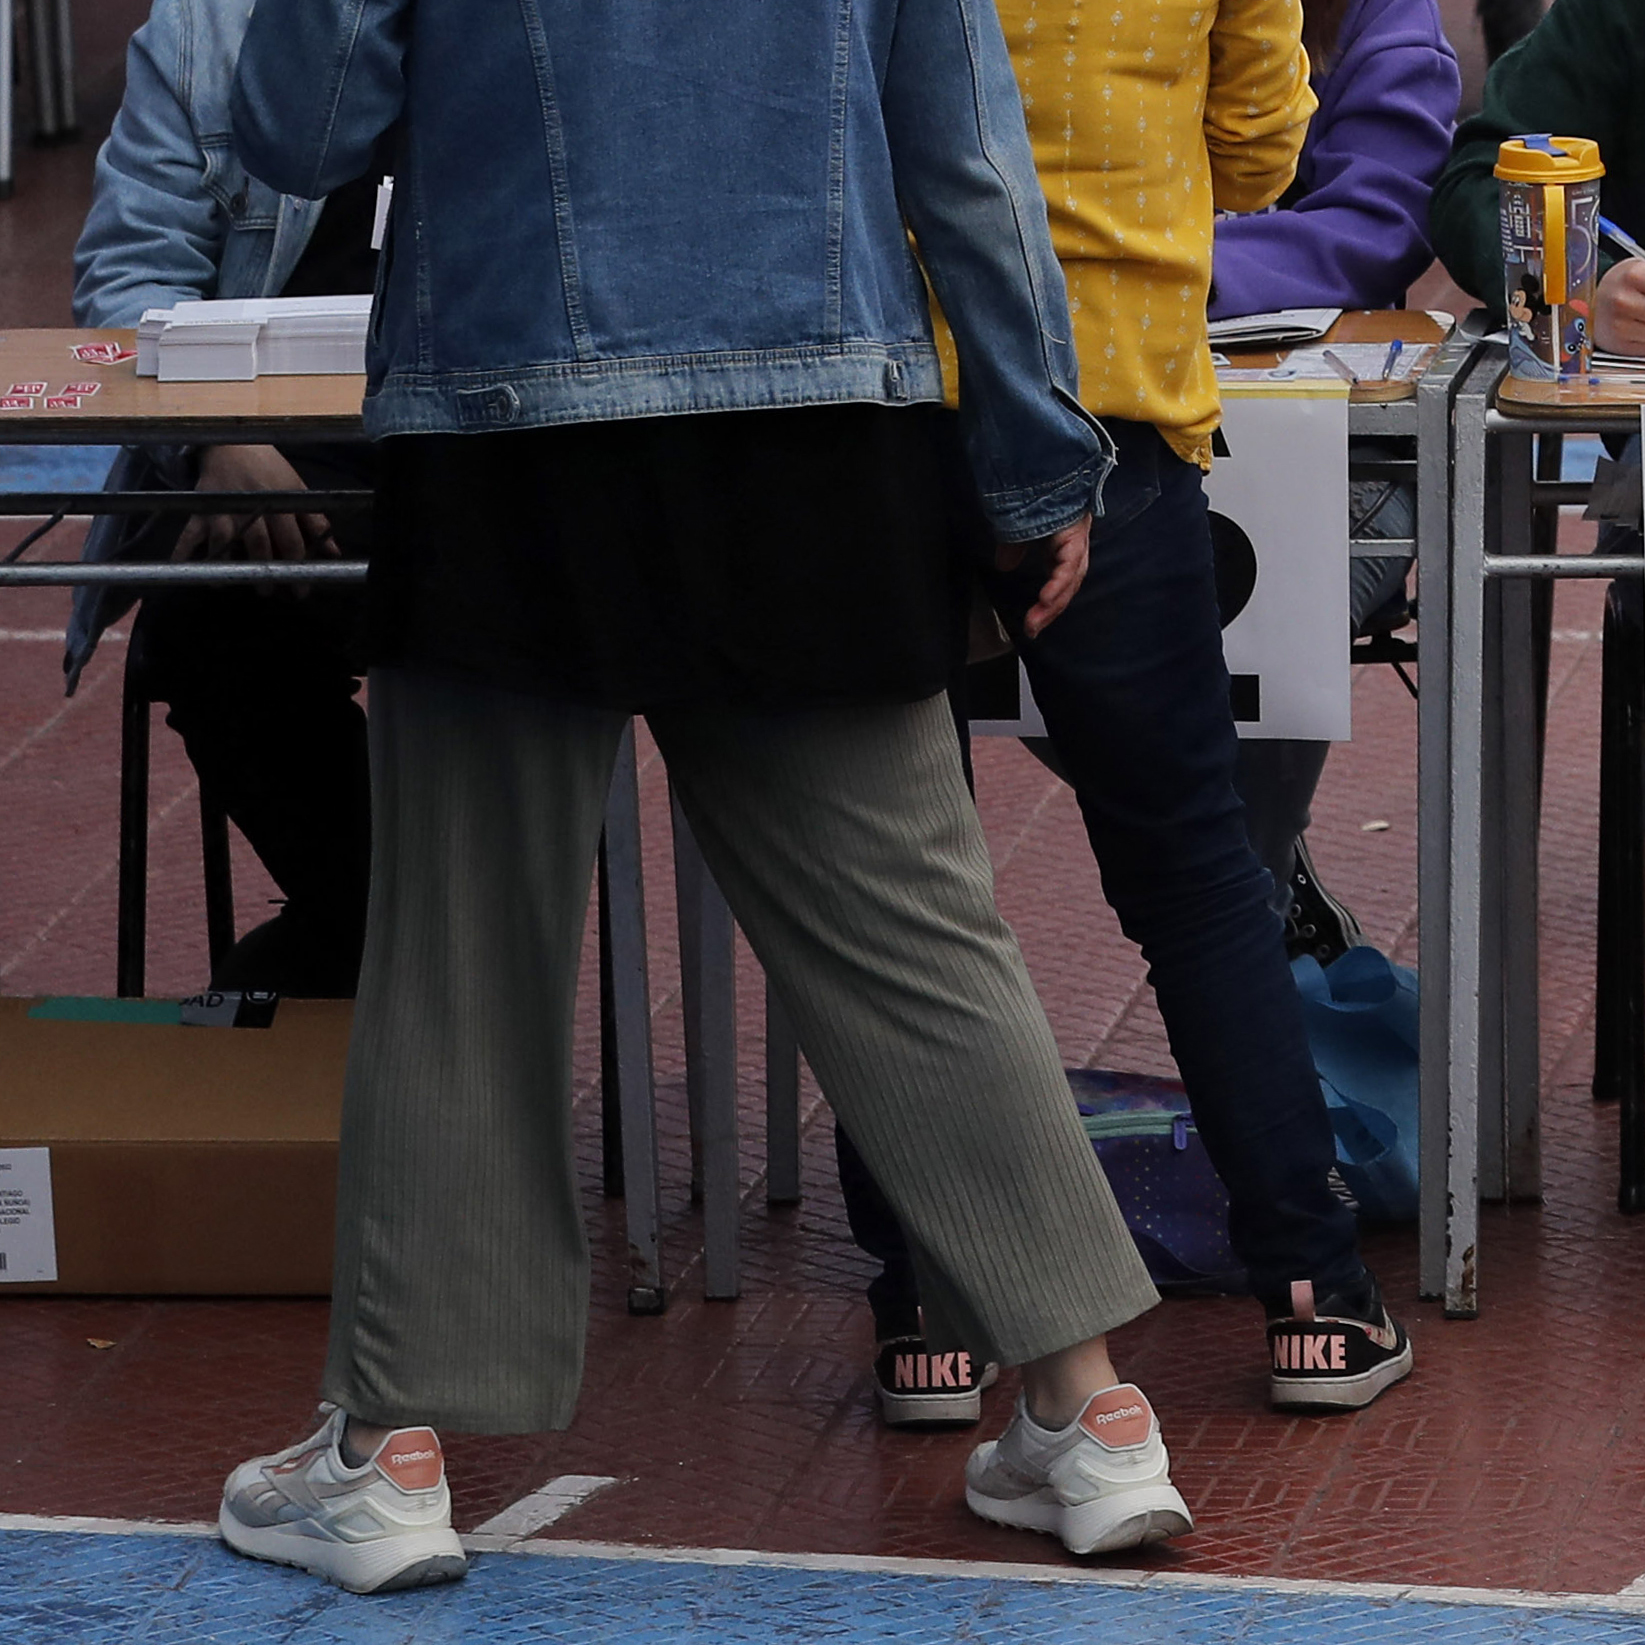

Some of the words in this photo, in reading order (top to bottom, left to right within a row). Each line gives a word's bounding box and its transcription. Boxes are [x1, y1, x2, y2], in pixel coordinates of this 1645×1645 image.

[1273, 1334, 1346, 1370] NIKE
[895, 1351, 972, 1388] NIKE
[1095, 1404, 1144, 1425] Reebok
[391, 1449, 436, 1465] Reebok
